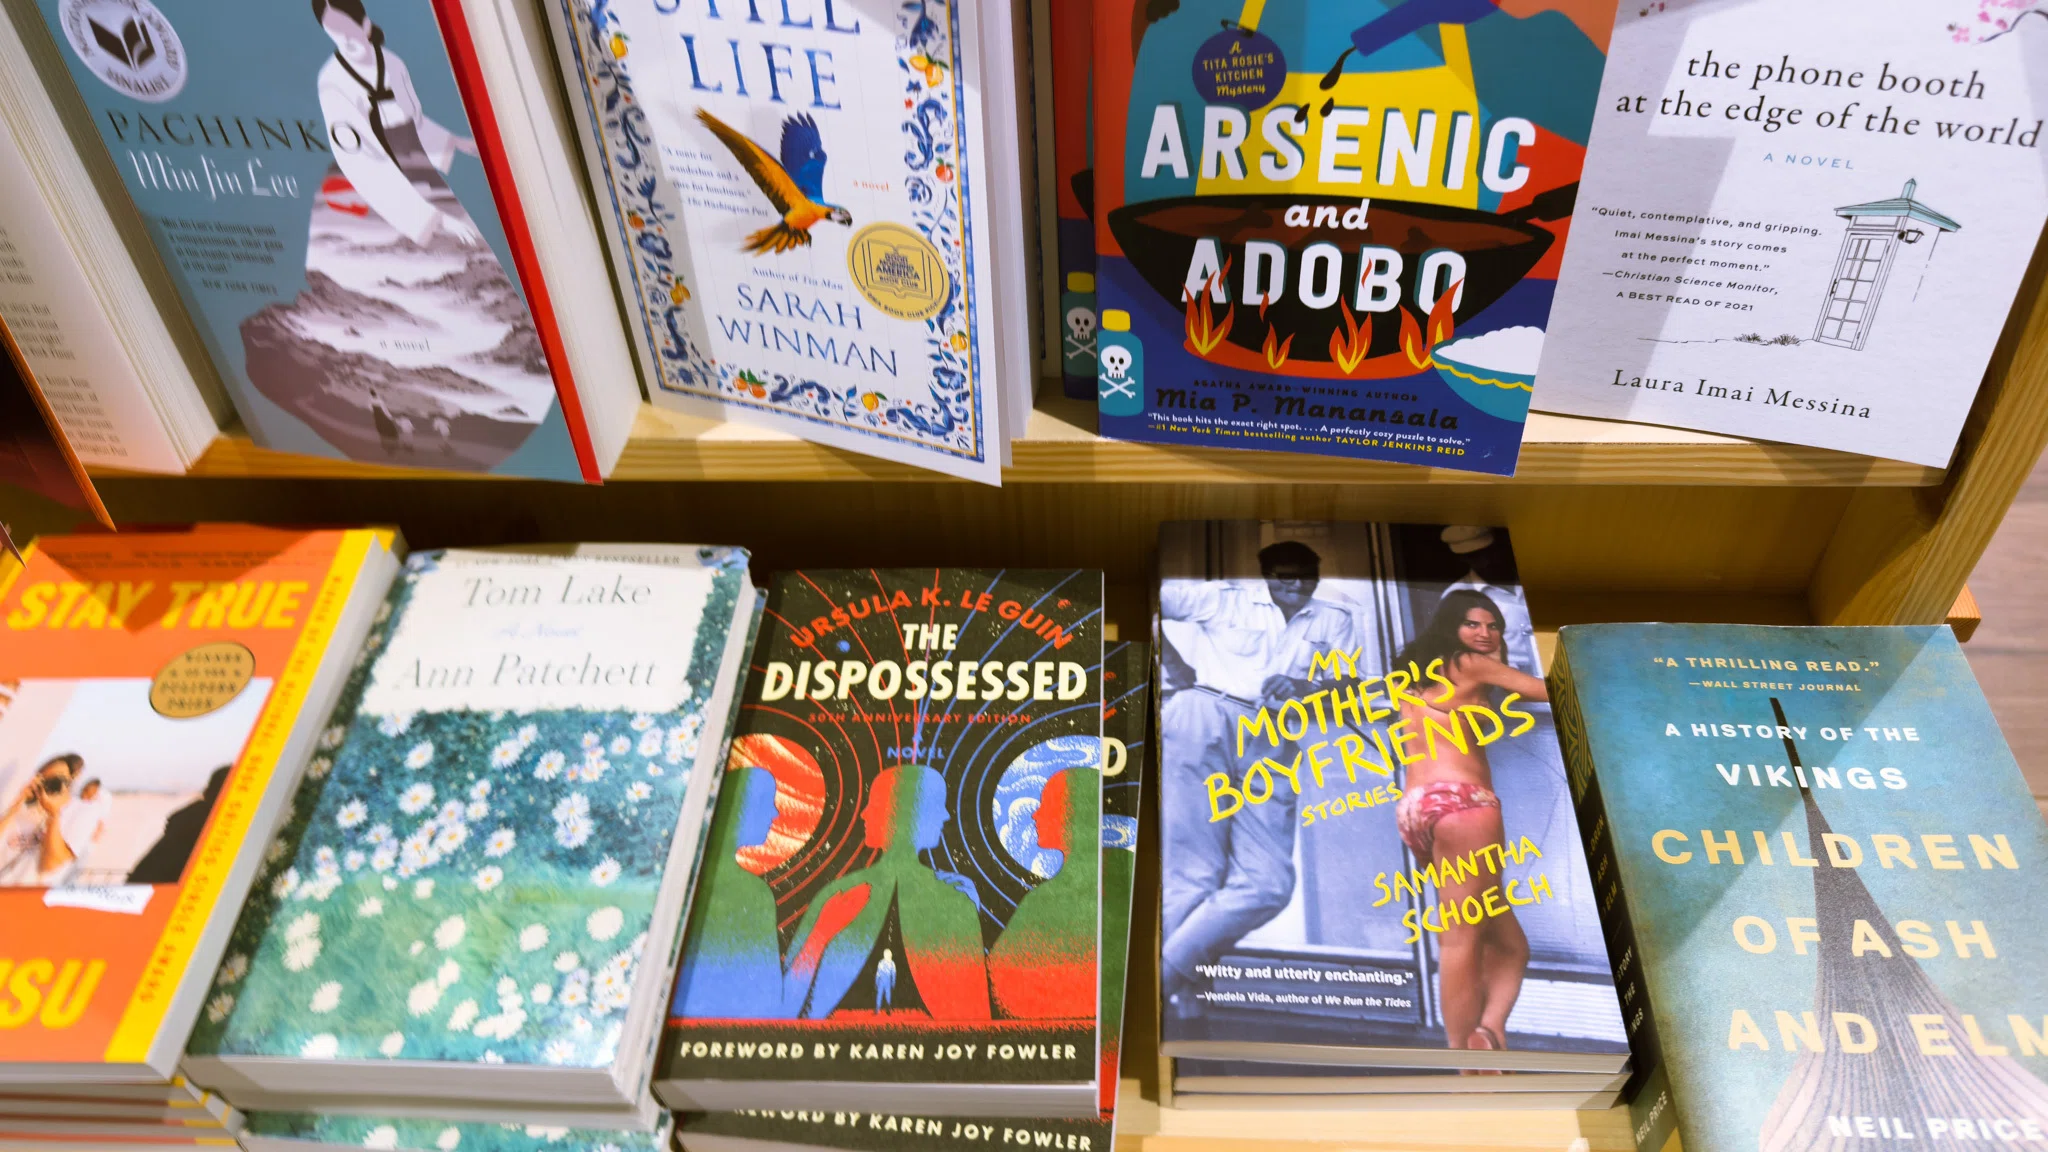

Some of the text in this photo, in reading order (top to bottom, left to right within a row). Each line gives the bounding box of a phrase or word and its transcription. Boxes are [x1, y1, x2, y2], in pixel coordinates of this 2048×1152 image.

[1229, 40, 1243, 55] A
[679, 32, 841, 110] LIFE
[1202, 57, 1228, 71] TITA
[1215, 67, 1264, 83] KITCHEN
[1687, 49, 1986, 100] the phone booth
[1216, 84, 1266, 97] Mystery
[105, 108, 362, 154] PACHINKO
[1616, 89, 2045, 149] at the edge of the world
[700, 151, 713, 161] for
[1140, 104, 1536, 193] ARSENIC
[1763, 152, 1855, 171] A NOVEL
[127, 149, 299, 202] Min Jin Lee
[692, 181, 705, 192] for
[716, 171, 733, 180] and
[852, 179, 890, 193] a novel
[703, 198, 769, 217] Washington Post
[1284, 198, 1371, 231] and
[1591, 206, 1824, 237] “Quiet, contemplative, and gripping.
[1614, 229, 1788, 253] Imai Messina’s story comes
[876, 264, 921, 281] AMERICA
[1180, 238, 1467, 316] ADOBO
[1621, 251, 1771, 272] at the perfect moment.”
[752, 266, 844, 291] Author of Man
[1674, 275, 1723, 288] Science
[1726, 281, 1779, 295] Monitor,
[737, 282, 863, 331] SARAH
[1628, 291, 1662, 302] BEST
[1666, 295, 1701, 306] READ
[1704, 300, 1721, 308] OF
[1725, 302, 1754, 312] 2021
[716, 314, 897, 378] WINMAN
[1193, 379, 1241, 389] AGATHA
[1365, 391, 1419, 402] AUTHOR
[1612, 369, 1871, 420] Laura Imai Messina
[1156, 387, 1459, 430] Mia P. Manansala
[1169, 424, 1465, 456] New York Times bestselling author TAYLOR JENKINS REID
[1172, 414, 1193, 424] book
[1195, 415, 1212, 424] hits
[1214, 416, 1229, 426] the
[1231, 419, 1254, 428] exact
[1256, 420, 1278, 431] right
[1320, 424, 1328, 433] A
[1330, 426, 1371, 438] perfectly
[1373, 430, 1394, 440] cozy
[1396, 431, 1424, 442] puzzle
[1427, 434, 1437, 443] to
[1438, 437, 1471, 446] solve.”
[6, 580, 311, 631] STAY TRUE
[465, 574, 652, 607] Tom Lake
[789, 586, 1075, 650] URSULA K. LE GUIN
[902, 623, 959, 650] THE
[393, 652, 659, 690] Ann Patchett
[760, 660, 1088, 701] DISPOSSESSED
[1307, 646, 1364, 683] MY
[1653, 657, 1879, 673] “A THRILLING READ.”
[1743, 681, 1793, 691] STREET
[1799, 683, 1861, 692] JOURNAL
[851, 712, 1032, 724] ANNIVERSARY EDITION
[1236, 657, 1456, 758] MOTHER'S
[1664, 723, 1920, 742] A HISTORY OF THE
[886, 746, 945, 759] NOVEL
[1203, 692, 1536, 823] BOYFRIENDS
[1715, 763, 1908, 790] VIKINGS
[1300, 781, 1404, 827] STORIES
[1651, 829, 2020, 870] CHILDREN
[1371, 835, 1543, 908] SAMANTHA
[1401, 872, 1554, 944] SCHOECH
[1732, 915, 1997, 959] OF ASH
[1245, 966, 1272, 979] and
[1274, 967, 1322, 983] utterly
[0, 958, 107, 1030] SU
[1247, 992, 1274, 1004] Vida,
[1275, 994, 1309, 1004] author
[1311, 994, 1324, 1004] of
[1325, 995, 1342, 1005] We
[1343, 996, 1363, 1006] Run
[1365, 996, 1382, 1007] the
[1384, 997, 1412, 1008] Tides
[1727, 1008, 1879, 1054] AND
[680, 1041, 1077, 1060] FOREWORD BY KAREN JOY FOWLER
[868, 1113, 1092, 1151] KAREN JOY FOWLER
[1636, 1091, 1668, 1145] NEIL PRICE
[1828, 1115, 2045, 1141] NEIL PRICE
